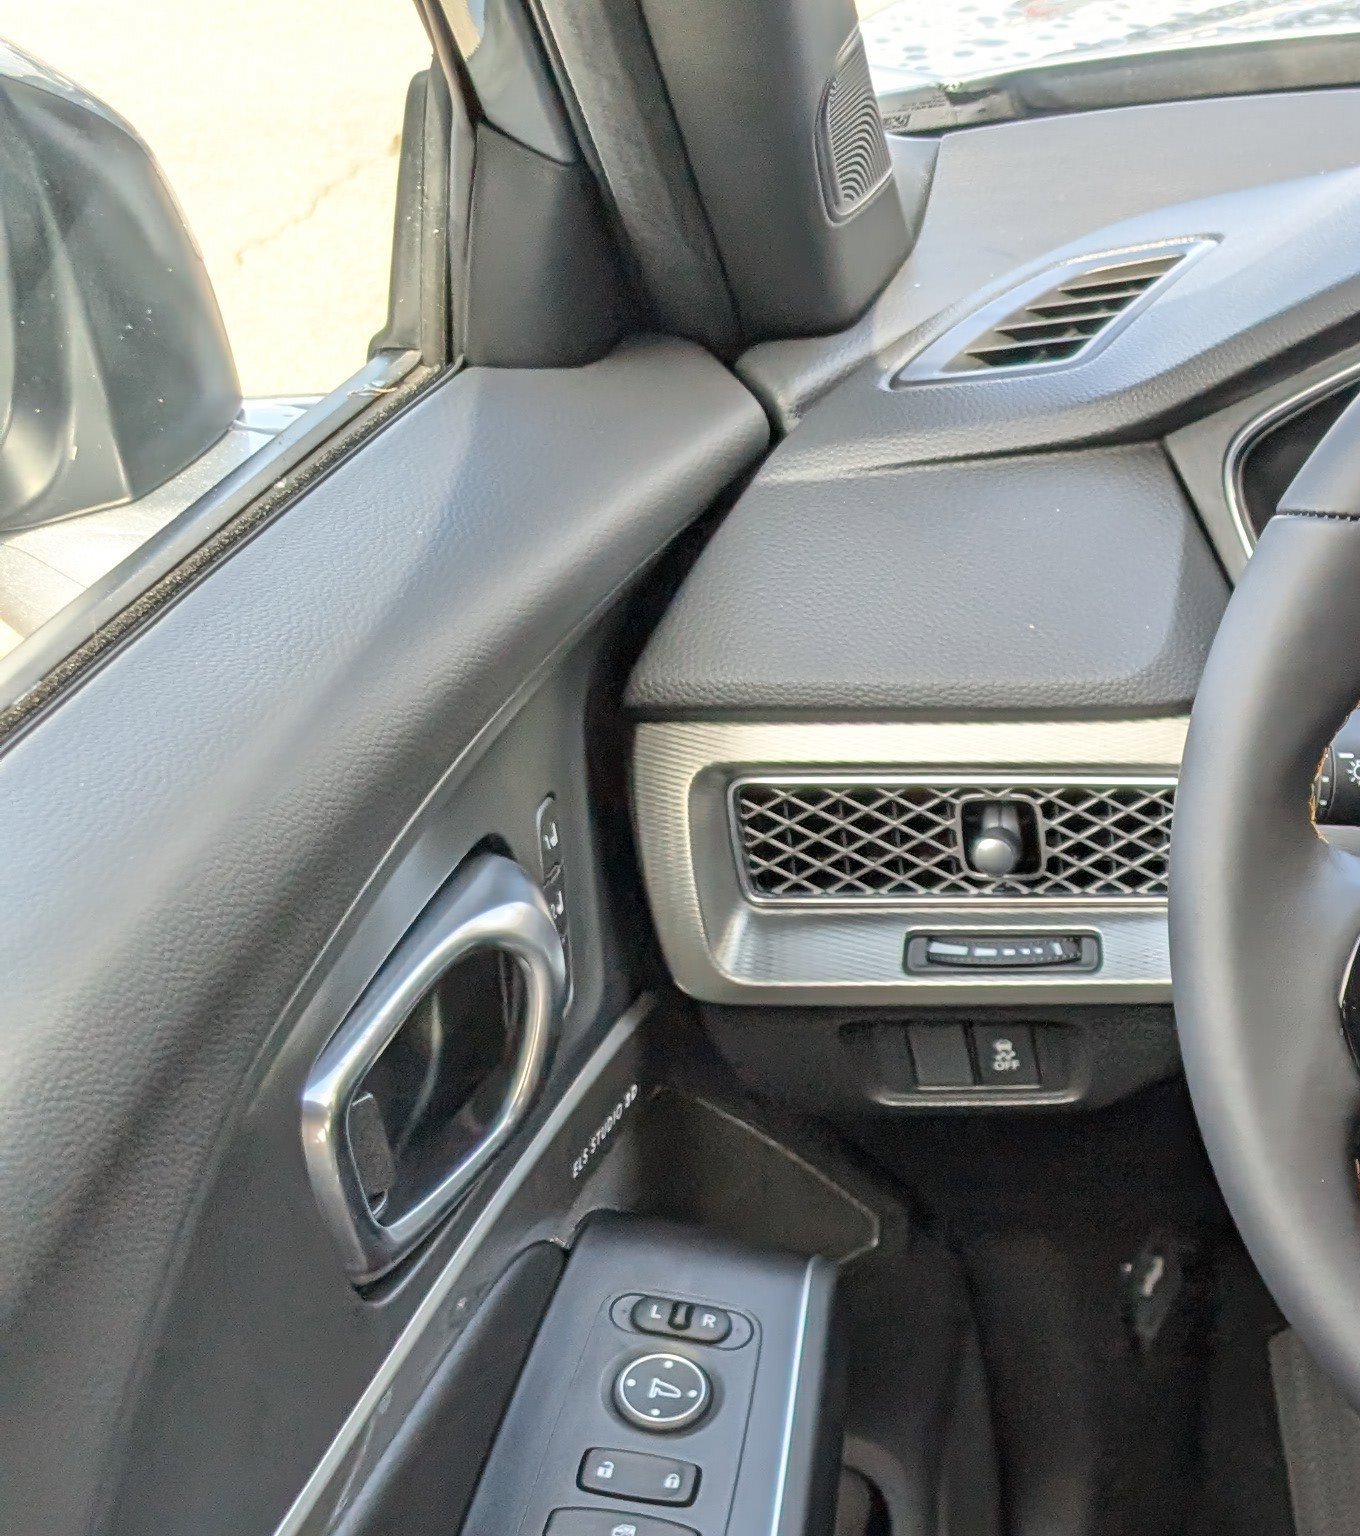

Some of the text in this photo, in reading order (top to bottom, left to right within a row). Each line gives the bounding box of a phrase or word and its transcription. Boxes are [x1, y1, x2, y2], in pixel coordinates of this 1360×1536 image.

[993, 1059, 1021, 1071] OFF
[650, 1304, 716, 1328] L R
